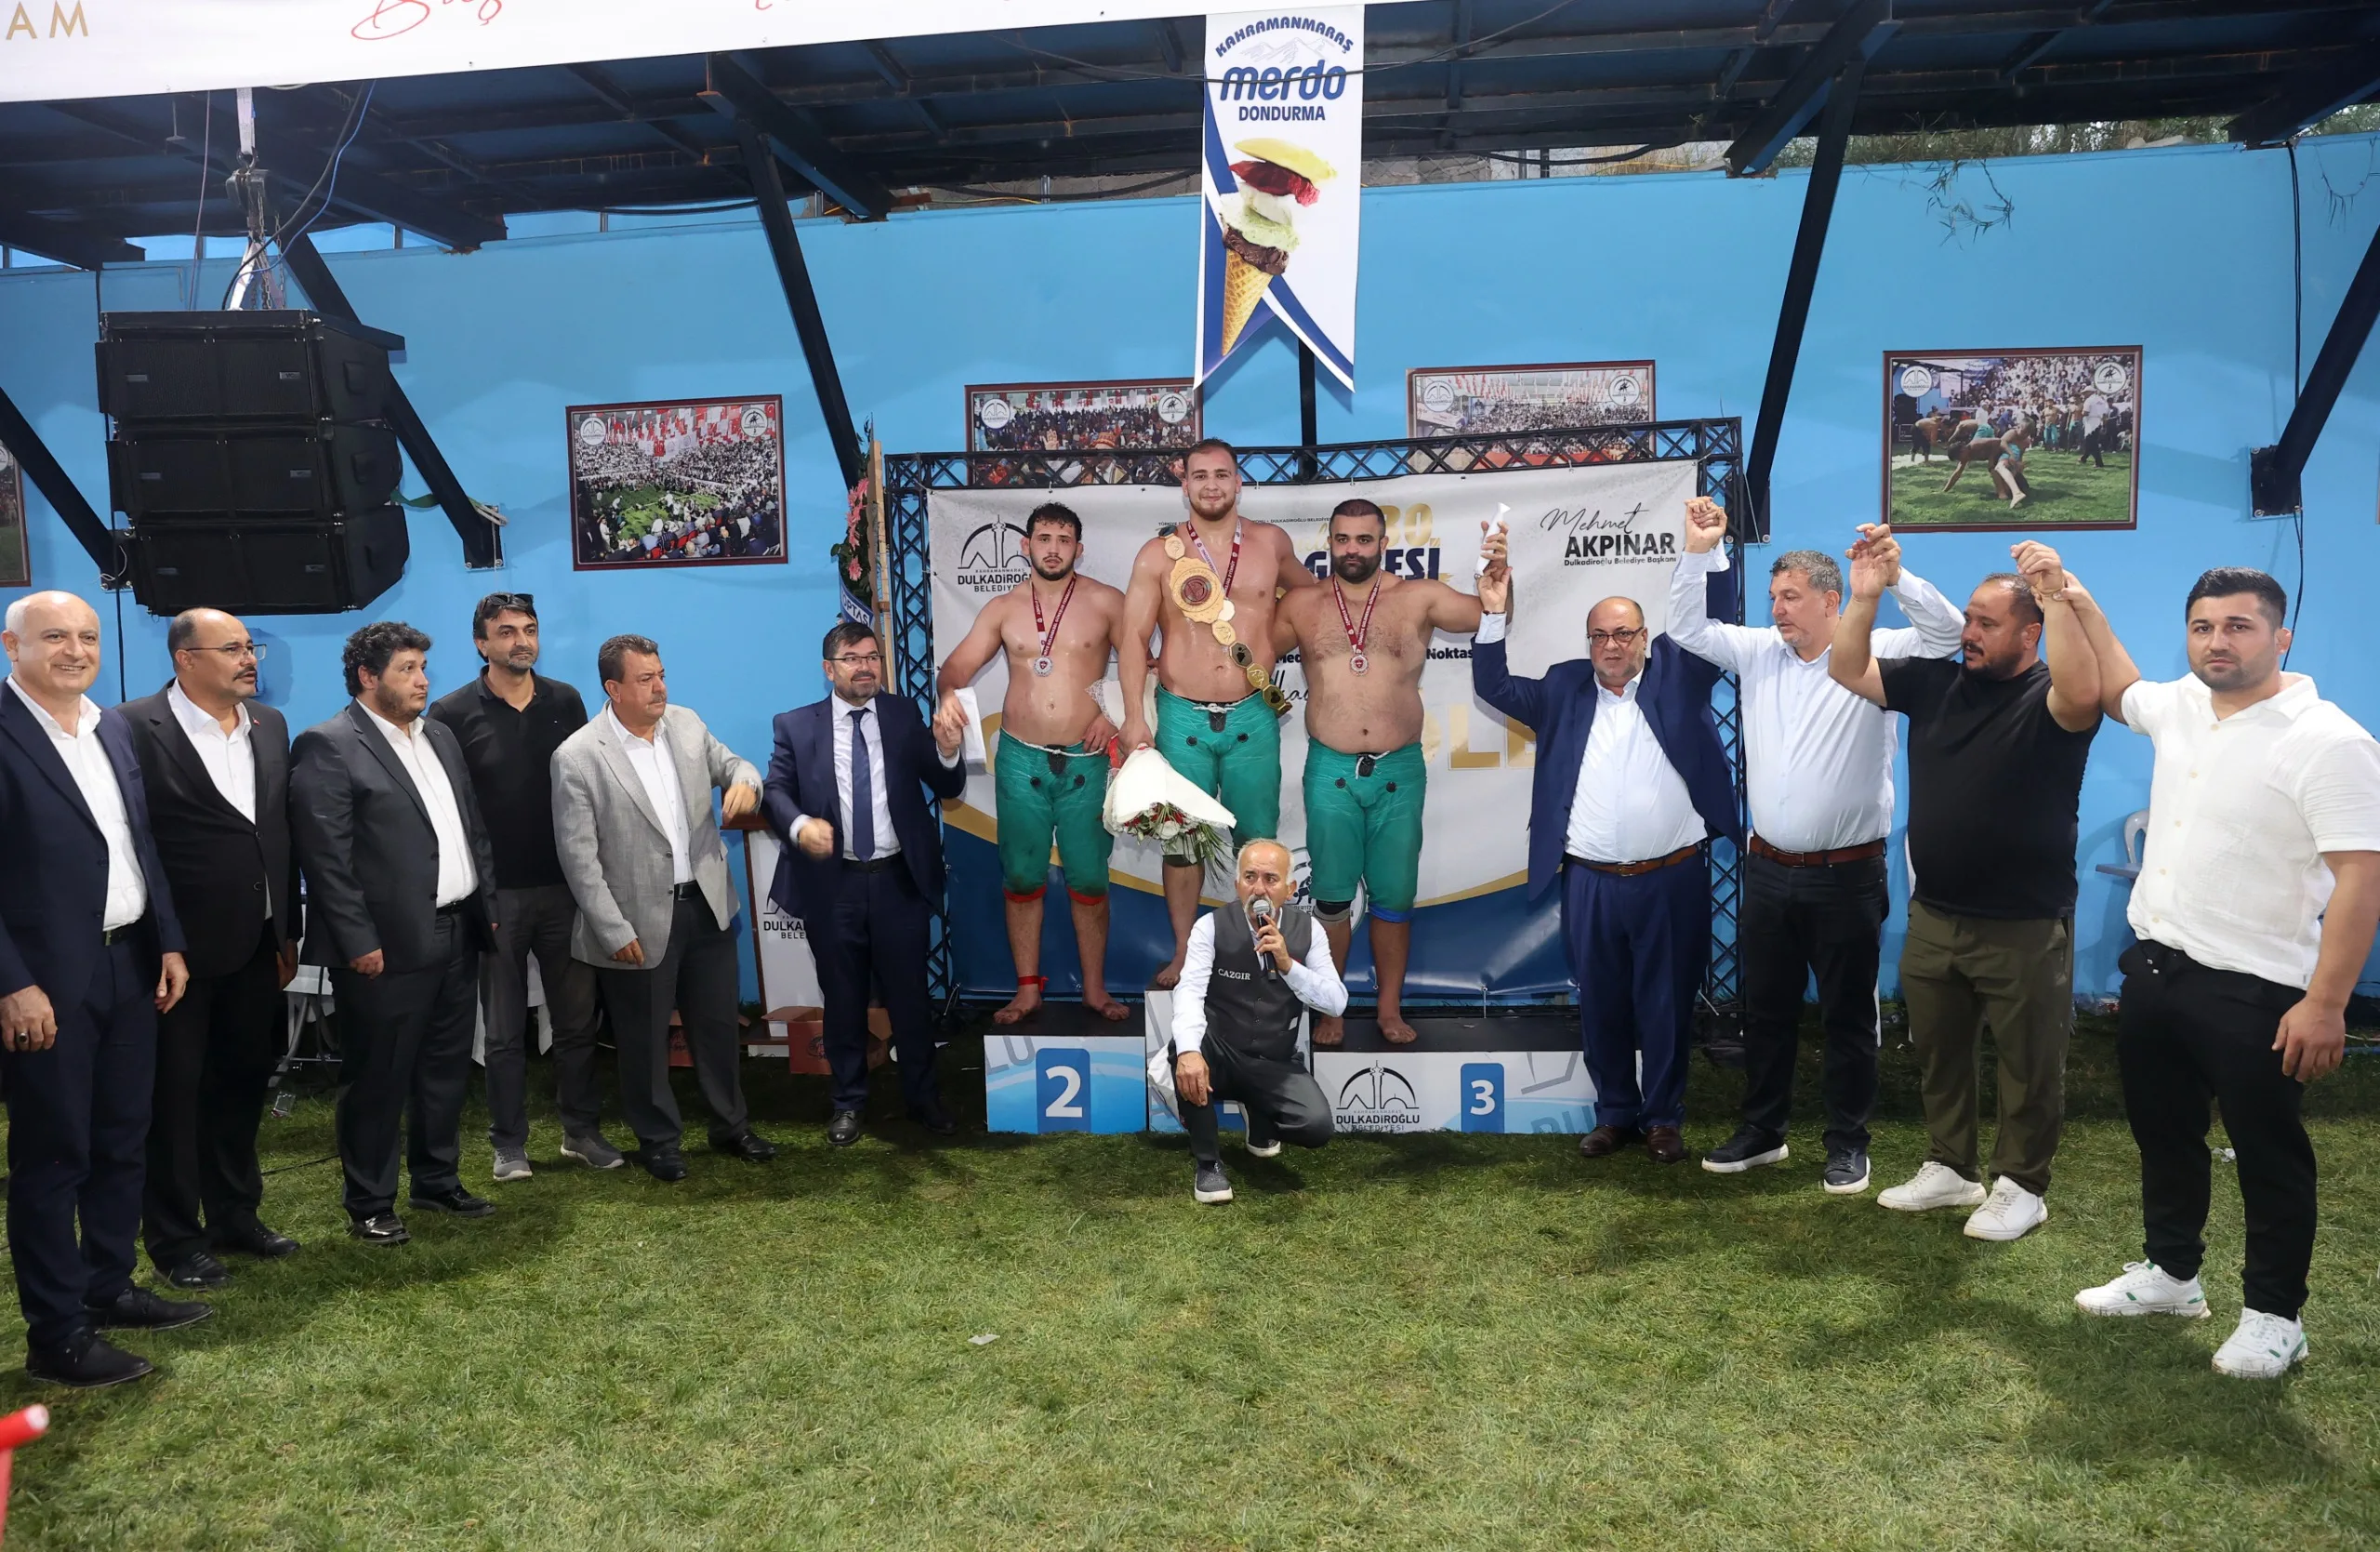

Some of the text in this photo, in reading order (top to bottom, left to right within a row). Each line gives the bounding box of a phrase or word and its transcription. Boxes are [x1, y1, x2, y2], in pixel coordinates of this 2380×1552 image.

[1214, 16, 1354, 58] KAHRAMANMARAŞ
[1219, 59, 1347, 101] merdo
[1238, 106, 1326, 121] DONDURMA
[1540, 501, 1650, 537] Mehmet
[1564, 558, 1612, 566] Dulkadiroğlu
[1647, 555, 1677, 564] Başkanı
[1565, 533, 1676, 558] AKPINAR
[763, 921, 804, 931] DULKA
[1218, 968, 1251, 980] CAZGIR
[1044, 1066, 1083, 1119] 2
[1470, 1080, 1496, 1115] 3
